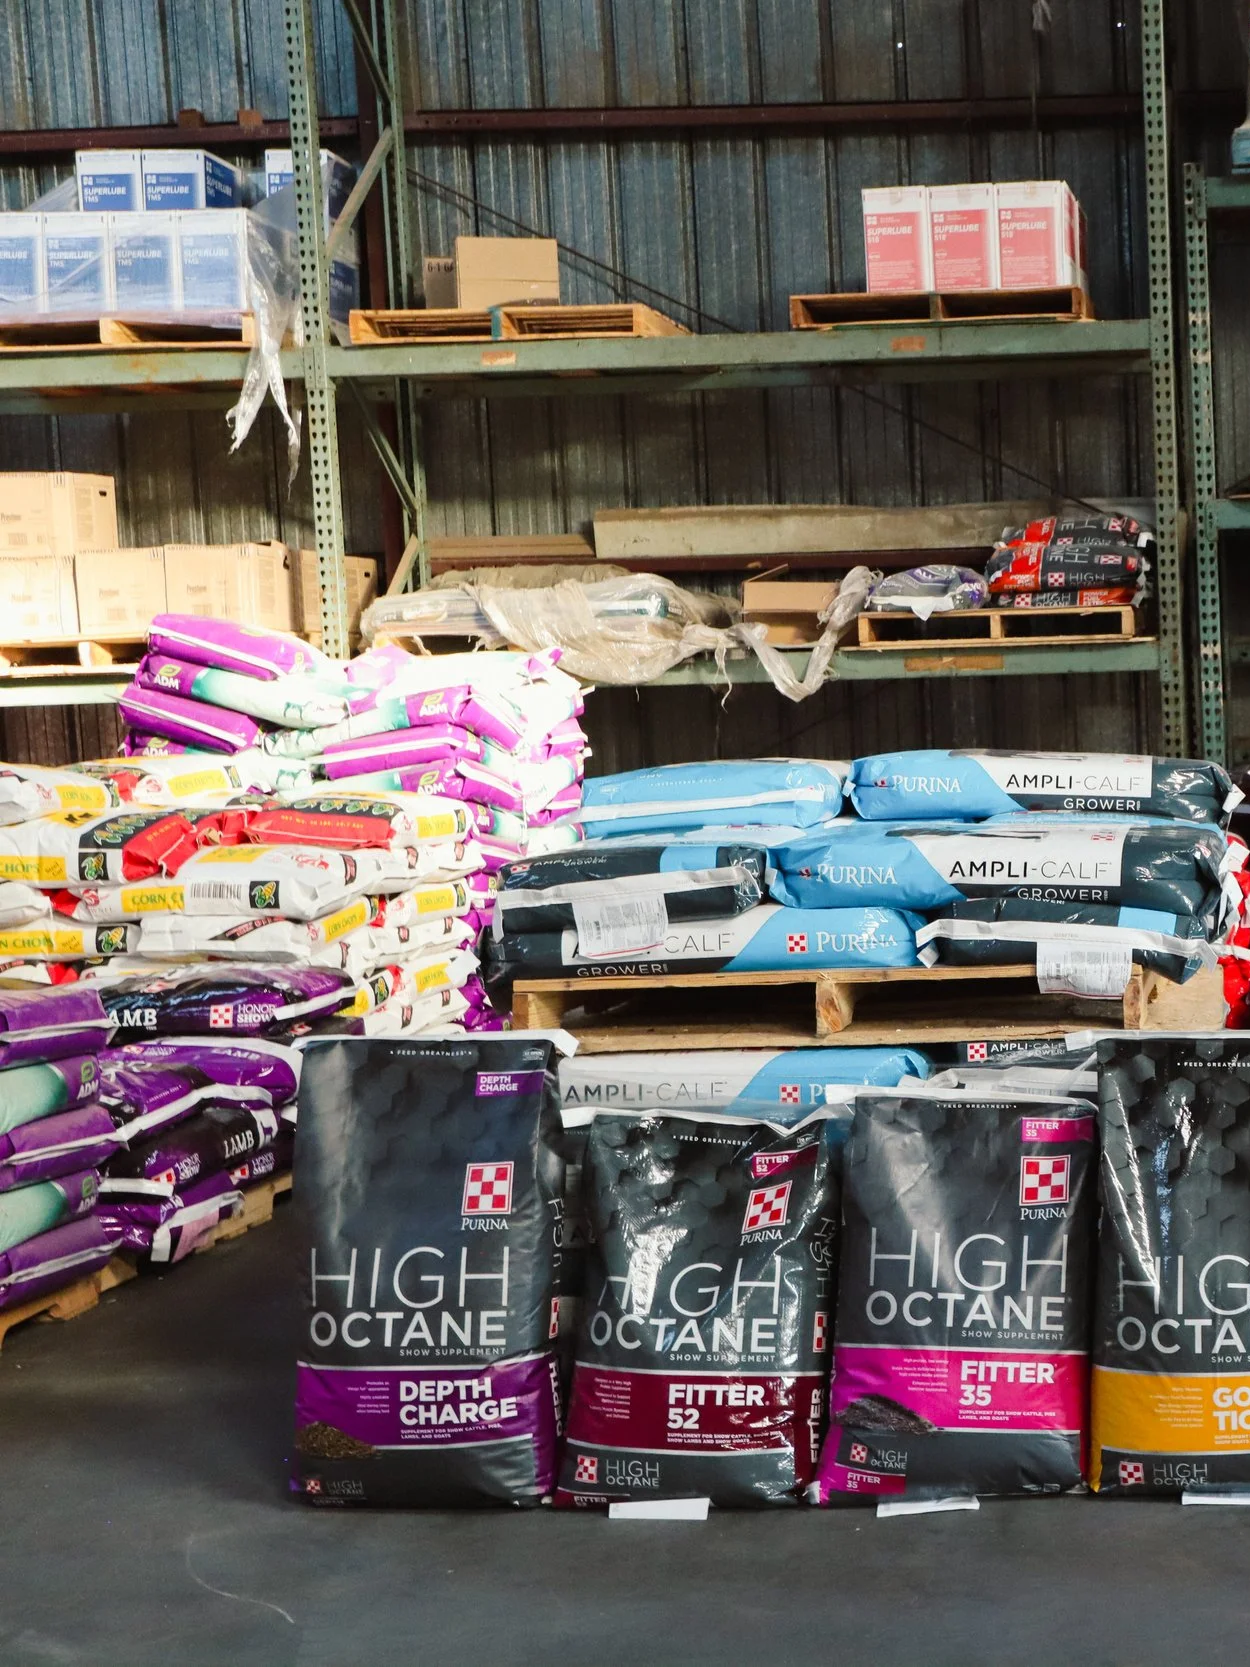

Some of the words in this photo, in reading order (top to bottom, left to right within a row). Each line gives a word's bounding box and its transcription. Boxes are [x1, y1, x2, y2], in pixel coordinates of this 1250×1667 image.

[84, 187, 127, 196] SUPERLUBE
[146, 185, 190, 195] SUPERLUBE
[84, 195, 99, 203] TMS
[867, 226, 913, 236] SUPERLUBE
[934, 224, 980, 234] SUPERLUBE
[1001, 221, 1047, 231] SUPERLUBE
[116, 249, 162, 259] SUPERLUBE
[184, 248, 230, 258] SUPERLUBE
[49, 259, 65, 268] TMS
[117, 258, 133, 267] TMS
[184, 257, 199, 265] TMS
[1069, 572, 1105, 582] HIGH
[1036, 592, 1071, 601] HIGH
[154, 674, 180, 690] ADM
[419, 703, 448, 717] ADM
[417, 782, 446, 796] ADM
[892, 773, 962, 796] PURINA
[1005, 773, 1141, 793] AMPLI-CALF
[1063, 797, 1137, 812] GROWER
[816, 862, 898, 889] PURINA
[949, 860, 1109, 881] AMPLI-CALF
[131, 894, 167, 906] CORN
[1017, 886, 1104, 902] GROWER
[816, 929, 898, 954] PURINA
[577, 963, 664, 977] GROWER
[237, 1003, 278, 1016] HONOR
[108, 1008, 158, 1027] AMB
[237, 1013, 276, 1024] SHOW
[479, 1075, 511, 1084] DEPTH
[479, 1083, 518, 1092] CHARGE
[564, 1080, 725, 1104] AMPLI-CALF
[1025, 1121, 1060, 1131] FITTER
[679, 1134, 699, 1142] FEED
[1025, 1130, 1038, 1138] 35
[223, 1129, 256, 1159] LAMB
[175, 1152, 201, 1174] HONOR
[251, 1151, 275, 1168] HONOR
[755, 1154, 790, 1165] FITTER
[755, 1164, 768, 1173] 52
[1020, 1207, 1068, 1221] PURINA
[461, 1217, 509, 1232] PURINA
[739, 1228, 783, 1246] PURINA
[869, 1226, 1069, 1293] HIGH
[310, 1245, 510, 1309] HIGH
[866, 1290, 1066, 1331] OCTANE
[310, 1310, 507, 1348] OCTANE
[590, 1310, 778, 1353] OCTANE
[961, 1330, 992, 1338] SHOW
[997, 1331, 1065, 1341] SUPPLEMENT
[399, 1349, 430, 1357] SHOW
[435, 1347, 507, 1357] SUPPLEMENT
[669, 1353, 702, 1361] SHOW
[1210, 1355, 1243, 1364] SHOW
[960, 1360, 1055, 1384] FITTER
[399, 1376, 493, 1402] DEPTH
[667, 1383, 765, 1407] FITTER
[959, 1384, 992, 1407] 35
[399, 1396, 518, 1426] CHARGE
[666, 1407, 700, 1430] 52
[605, 1458, 660, 1478] HIGH
[870, 1458, 907, 1470] OCTANE
[1153, 1463, 1208, 1478] HIGH
[605, 1475, 660, 1487] OCTANE
[846, 1480, 858, 1489] 35
[847, 1471, 881, 1485] FITTER
[1153, 1476, 1207, 1487] OCTANE
